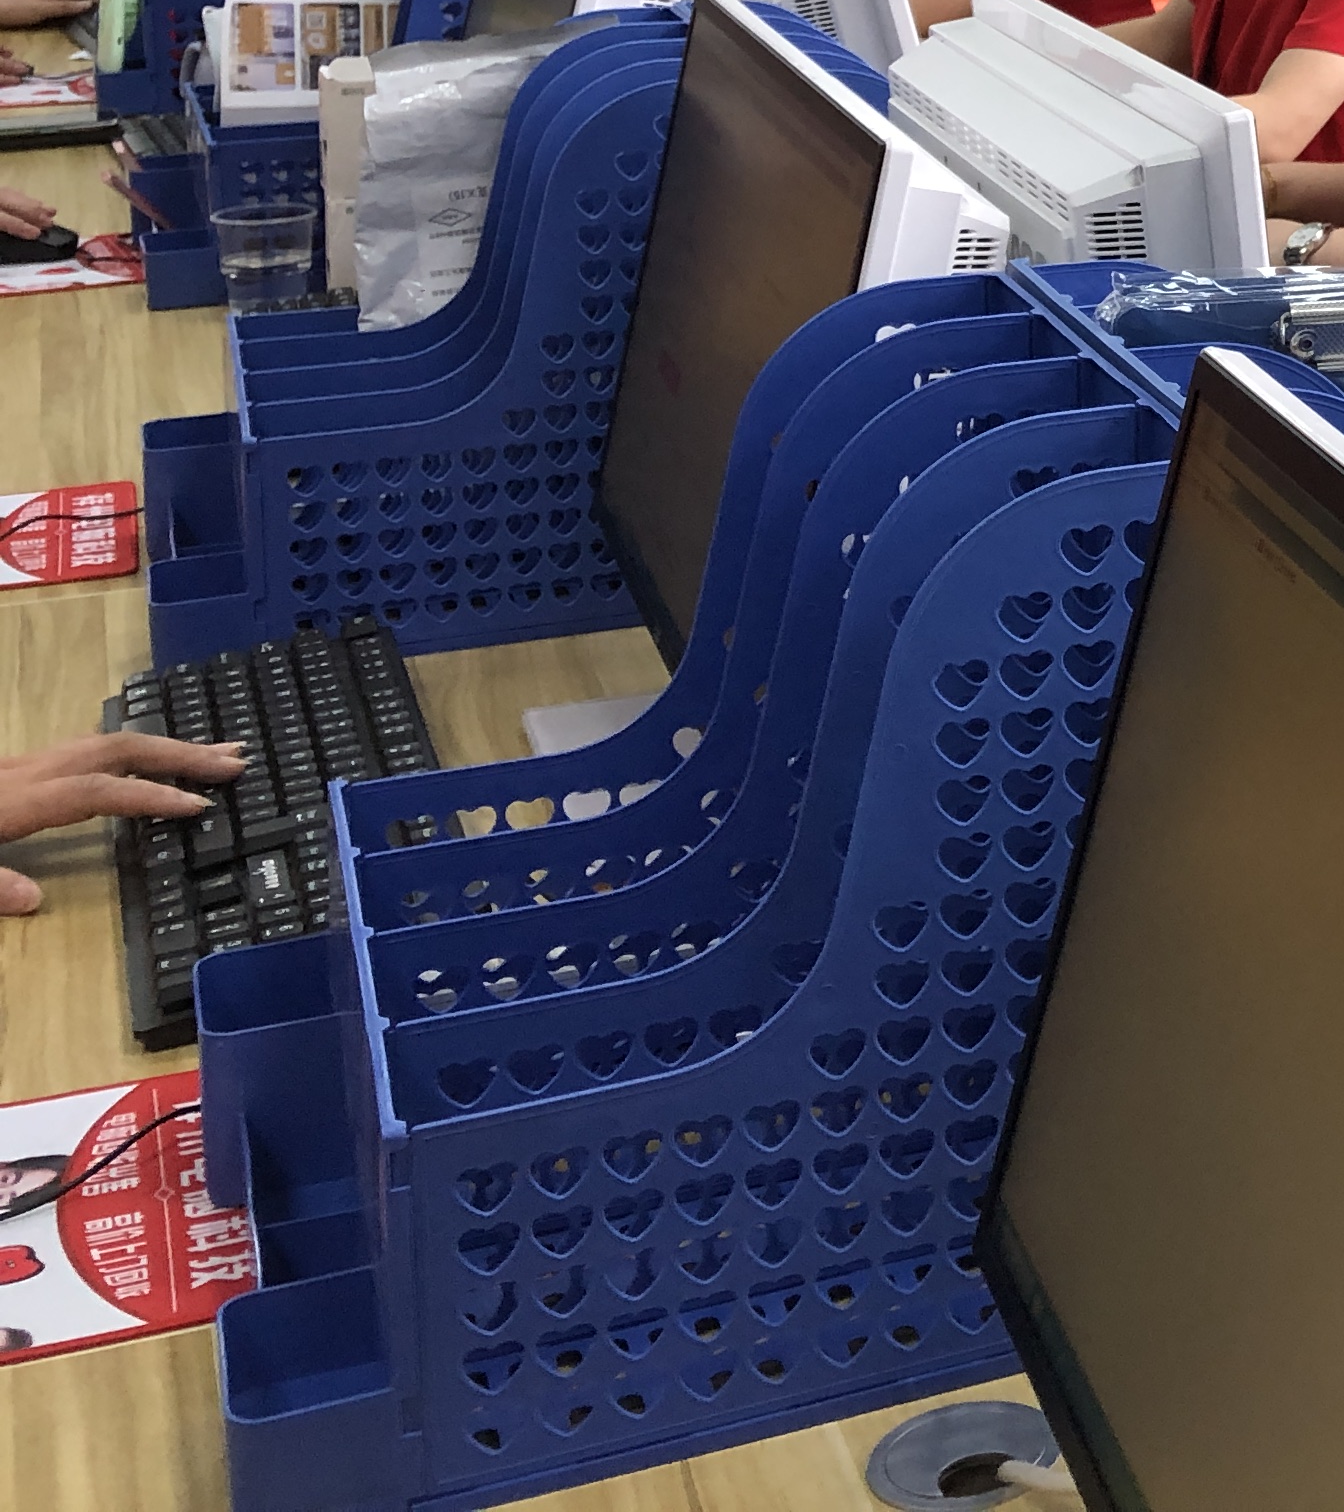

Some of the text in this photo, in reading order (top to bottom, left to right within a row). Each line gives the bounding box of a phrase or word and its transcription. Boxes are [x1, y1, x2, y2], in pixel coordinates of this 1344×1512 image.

[84, 1210, 151, 1301] 高价上门回收
